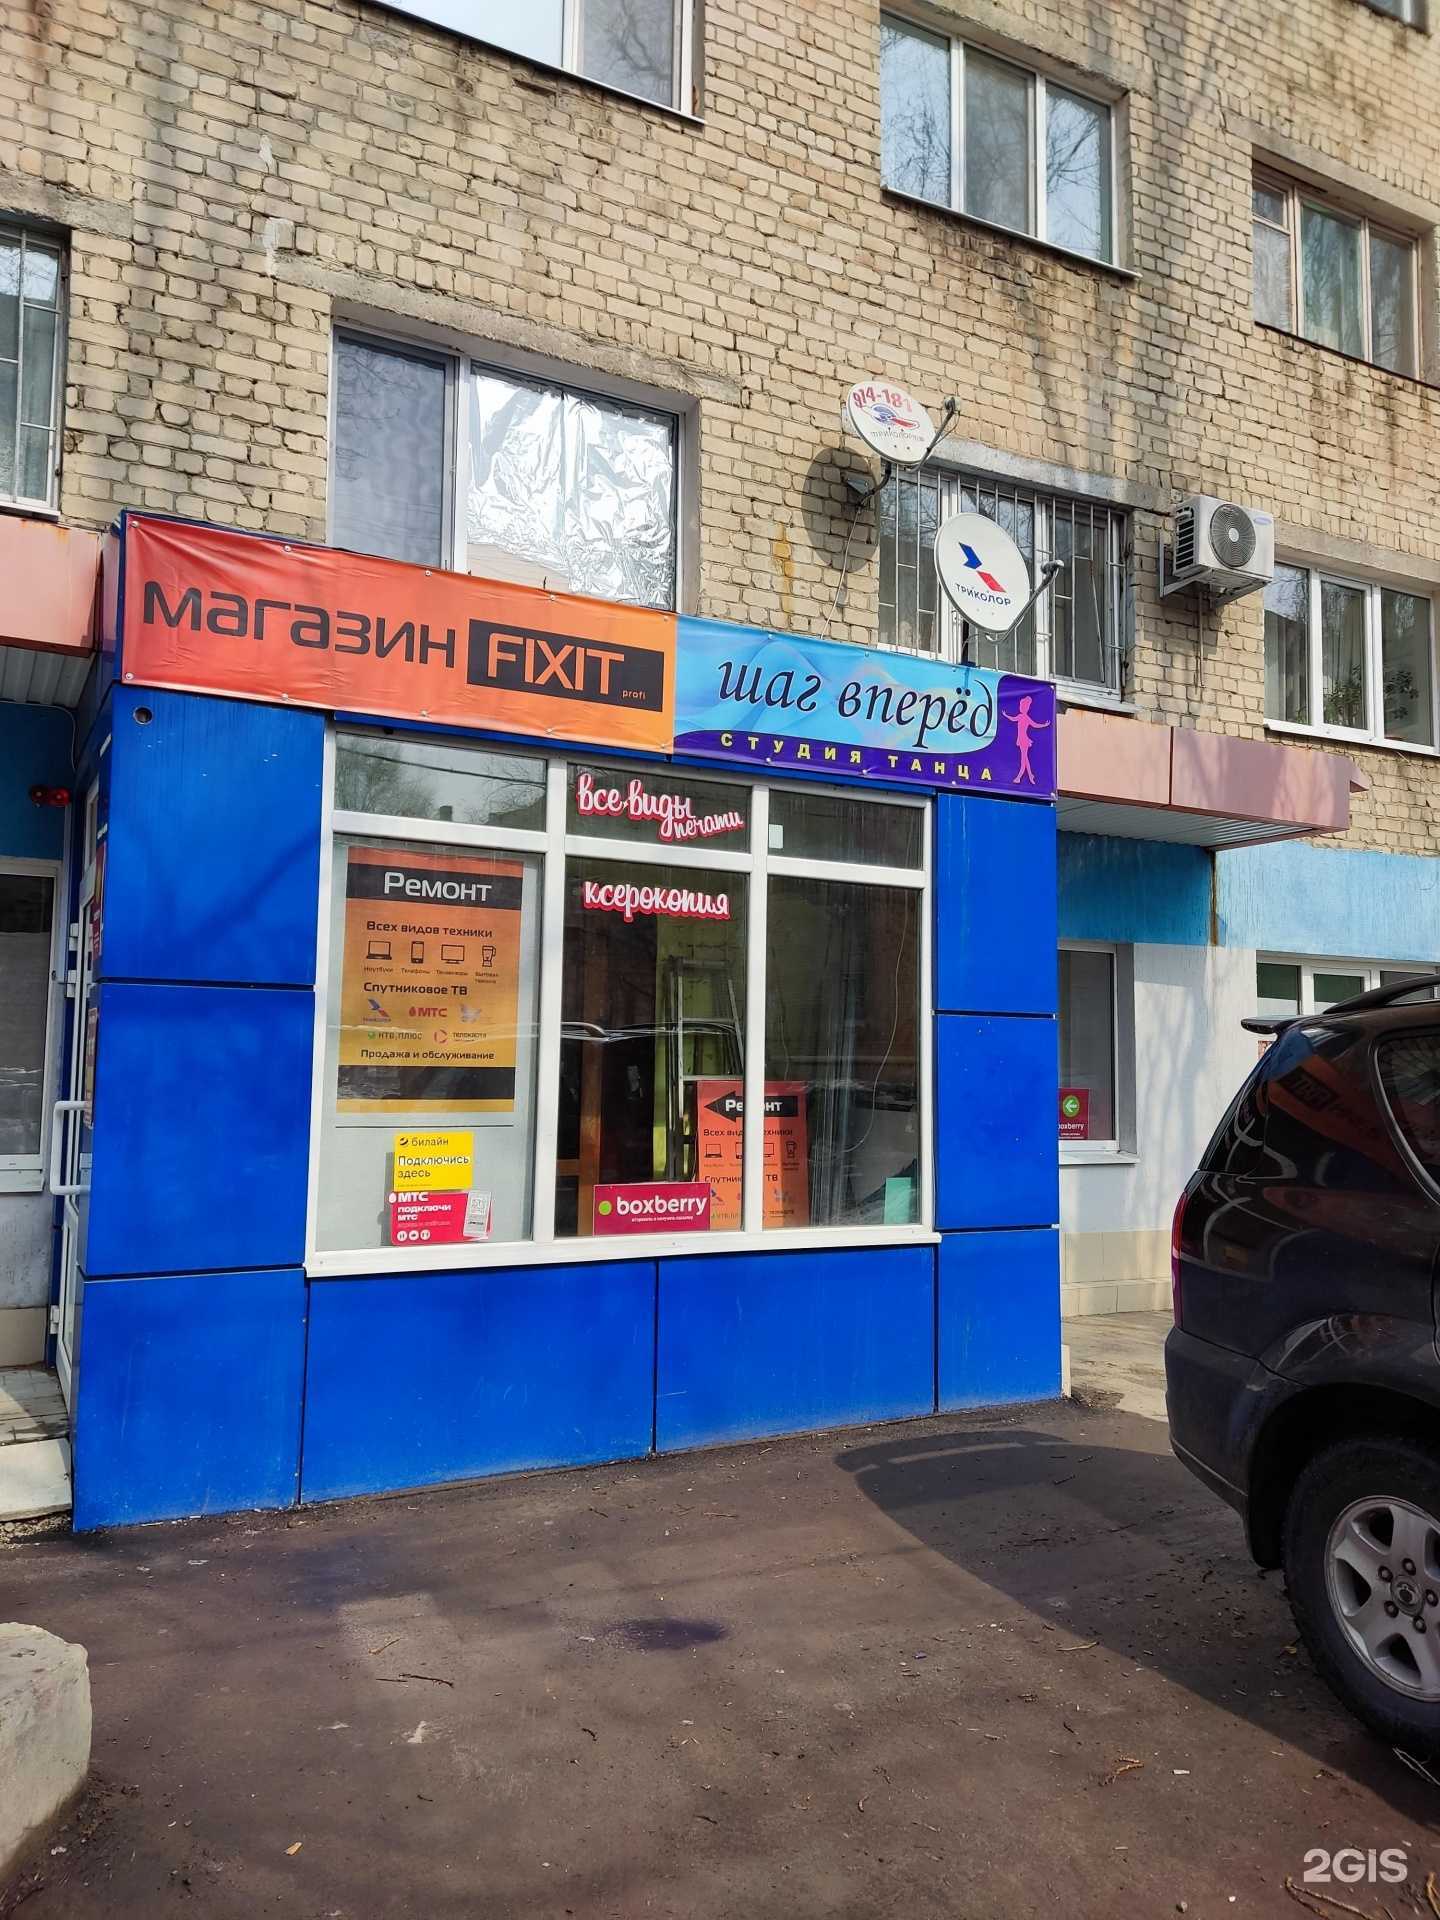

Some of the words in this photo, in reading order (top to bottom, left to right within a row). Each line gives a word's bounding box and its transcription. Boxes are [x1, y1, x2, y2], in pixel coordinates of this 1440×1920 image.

[955, 583, 1011, 606] ТРИКОЛОР
[487, 632, 625, 695] FIXIT
[622, 689, 646, 700] profi
[717, 661, 822, 713] шаг
[838, 678, 994, 749] вперёд
[720, 732, 862, 764] СТУДИЯ
[887, 755, 993, 782] ТАНЦА
[576, 773, 622, 815] все
[625, 778, 697, 841] виды
[673, 811, 745, 840] печати
[383, 870, 493, 902] Ремонт
[583, 880, 731, 922] ксерокопия
[366, 920, 398, 932] Всех
[401, 924, 440, 936] видов
[443, 926, 493, 939] техники
[363, 981, 449, 996] Спутниковое
[451, 984, 468, 996] ТВ
[417, 1006, 448, 1018] МТС
[361, 1049, 411, 1060] Продажа
[413, 1051, 420, 1059] и
[422, 1049, 495, 1061] обслуживание
[703, 1128, 724, 1137] Всех
[411, 1136, 449, 1147] билайн
[398, 1154, 469, 1167] Подключись
[397, 1168, 431, 1179] здесь
[766, 1173, 779, 1182] ТВ
[398, 1191, 429, 1203] МТС
[616, 1194, 707, 1216] boxberry
[397, 1214, 418, 1222] МТС
